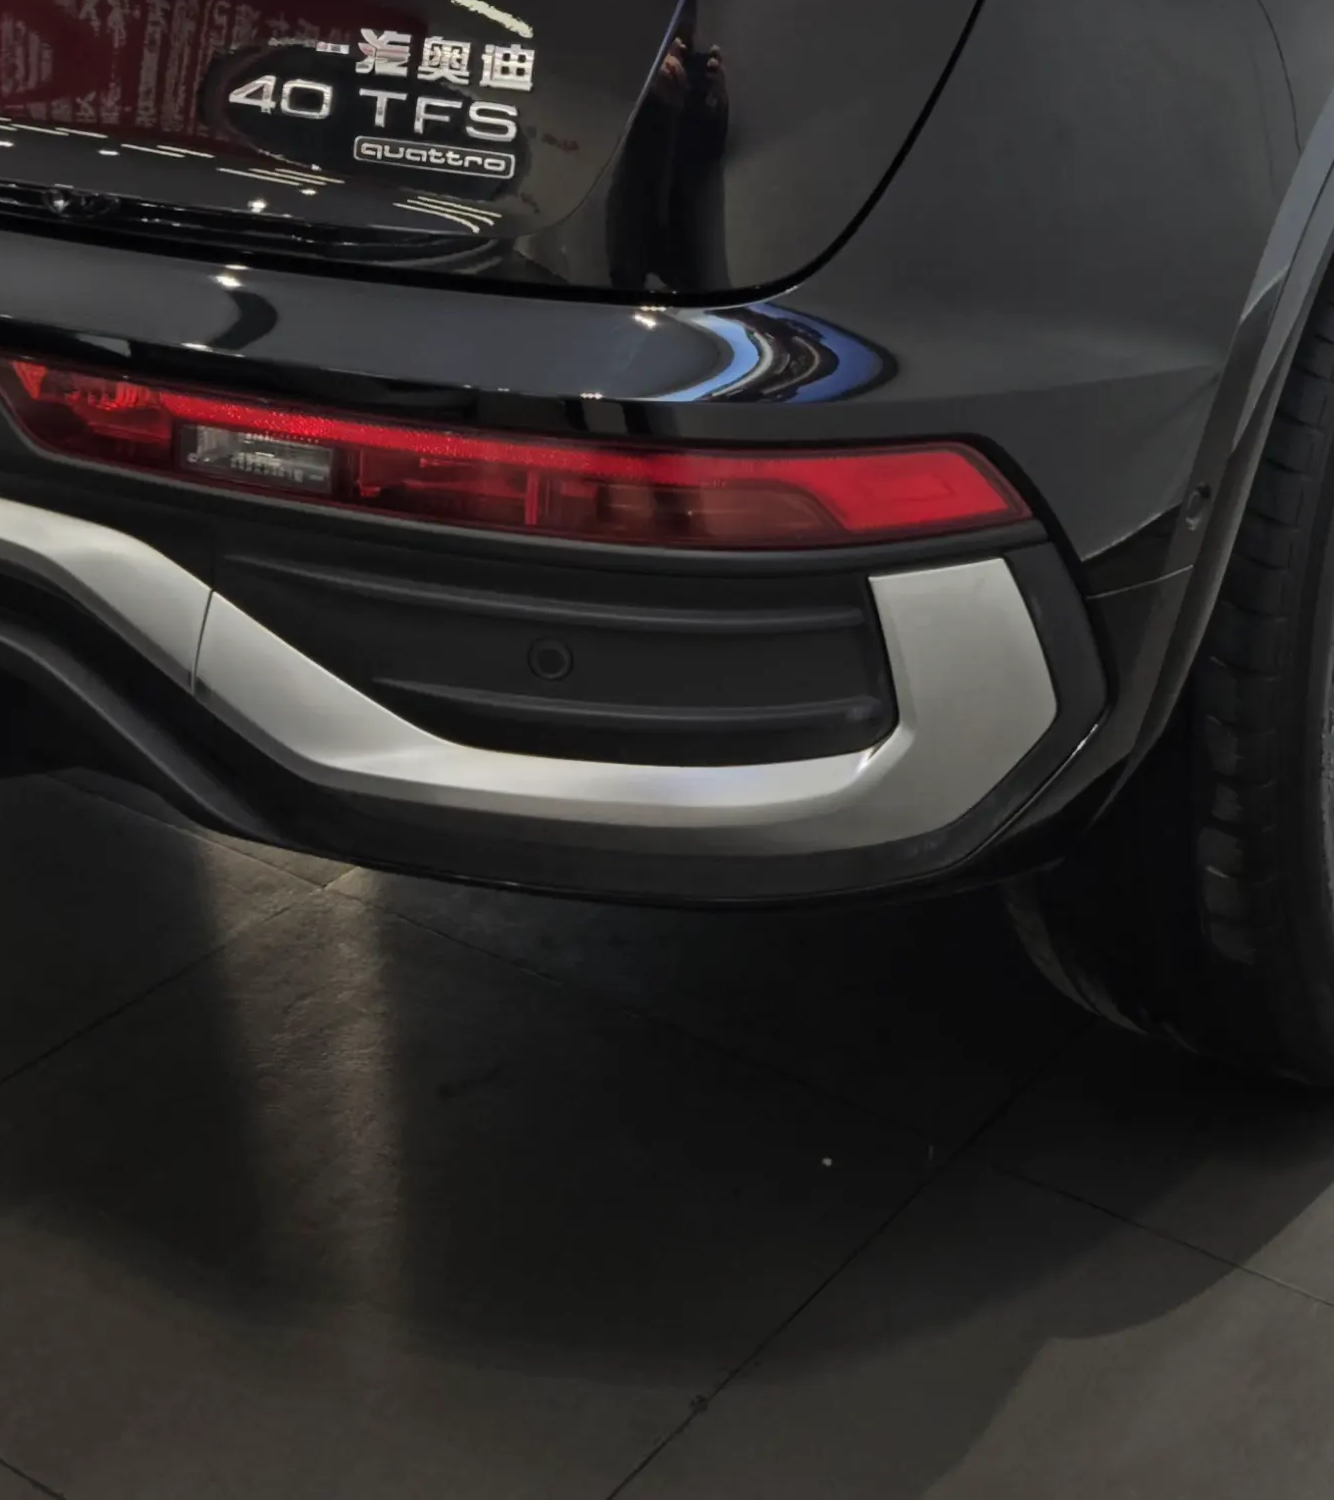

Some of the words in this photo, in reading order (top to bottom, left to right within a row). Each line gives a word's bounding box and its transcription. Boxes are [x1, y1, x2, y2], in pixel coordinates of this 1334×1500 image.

[316, 28, 535, 92] 一汽奥迪
[228, 74, 333, 120] 40
[359, 88, 518, 142] TFS
[360, 141, 507, 172] quattro
